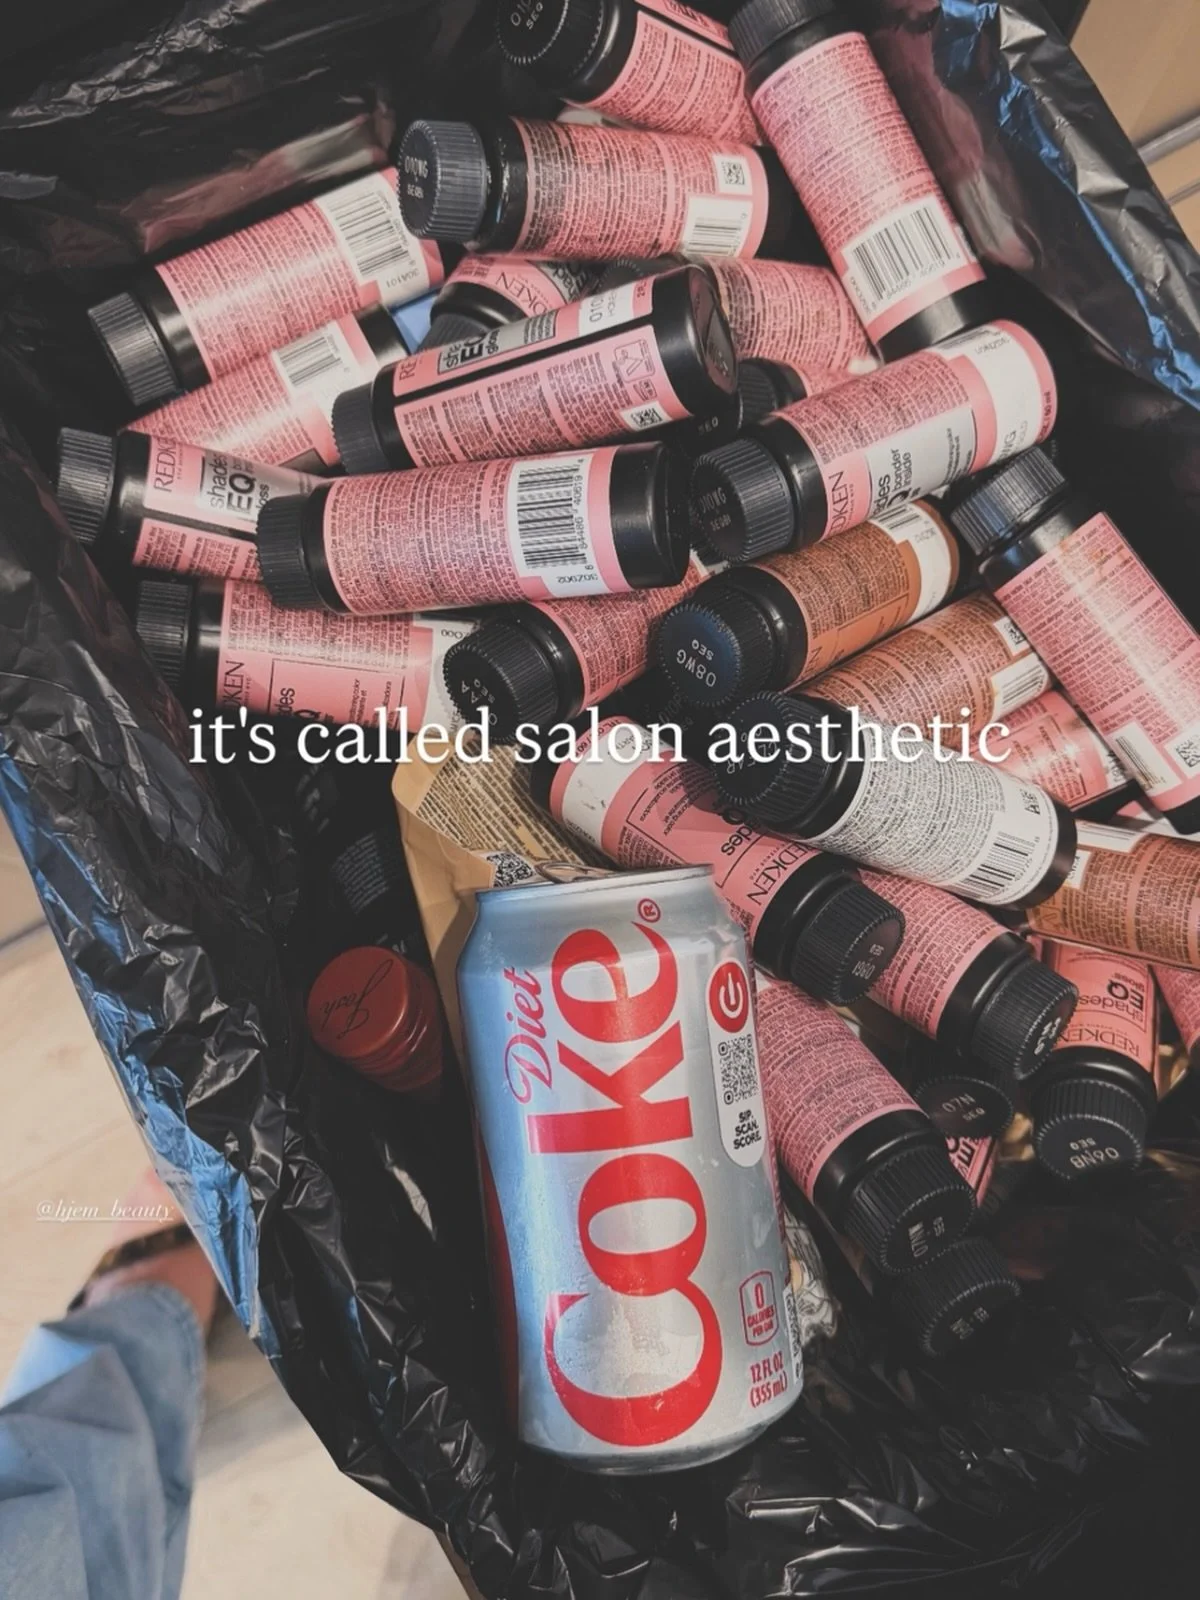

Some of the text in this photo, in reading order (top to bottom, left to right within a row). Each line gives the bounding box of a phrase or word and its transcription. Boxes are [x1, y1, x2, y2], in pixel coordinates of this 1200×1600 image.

[891, 448, 902, 491] bonder
[902, 452, 912, 486] inside
[227, 473, 257, 514] EQ
[255, 484, 270, 510] loss
[828, 470, 846, 529] DKEN
[692, 639, 714, 661] SEQ
[676, 649, 717, 687] 08WG
[462, 681, 498, 725] 0AA
[721, 823, 754, 857] des
[747, 841, 812, 906] EDKEN
[1078, 995, 1144, 1024] shades
[1107, 979, 1144, 1011] EQ
[504, 966, 552, 1107] Diet
[735, 1119, 760, 1137] SCAN.
[738, 1109, 754, 1124] SIP.
[962, 1107, 986, 1121] SEQ
[1069, 1136, 1096, 1151] SEQ
[1070, 1146, 1120, 1169] 06NB
[527, 920, 724, 1448] Coke
[754, 1282, 765, 1310] 0
[750, 1350, 784, 1384] 12 FL OZ
[750, 1381, 773, 1408] (355
